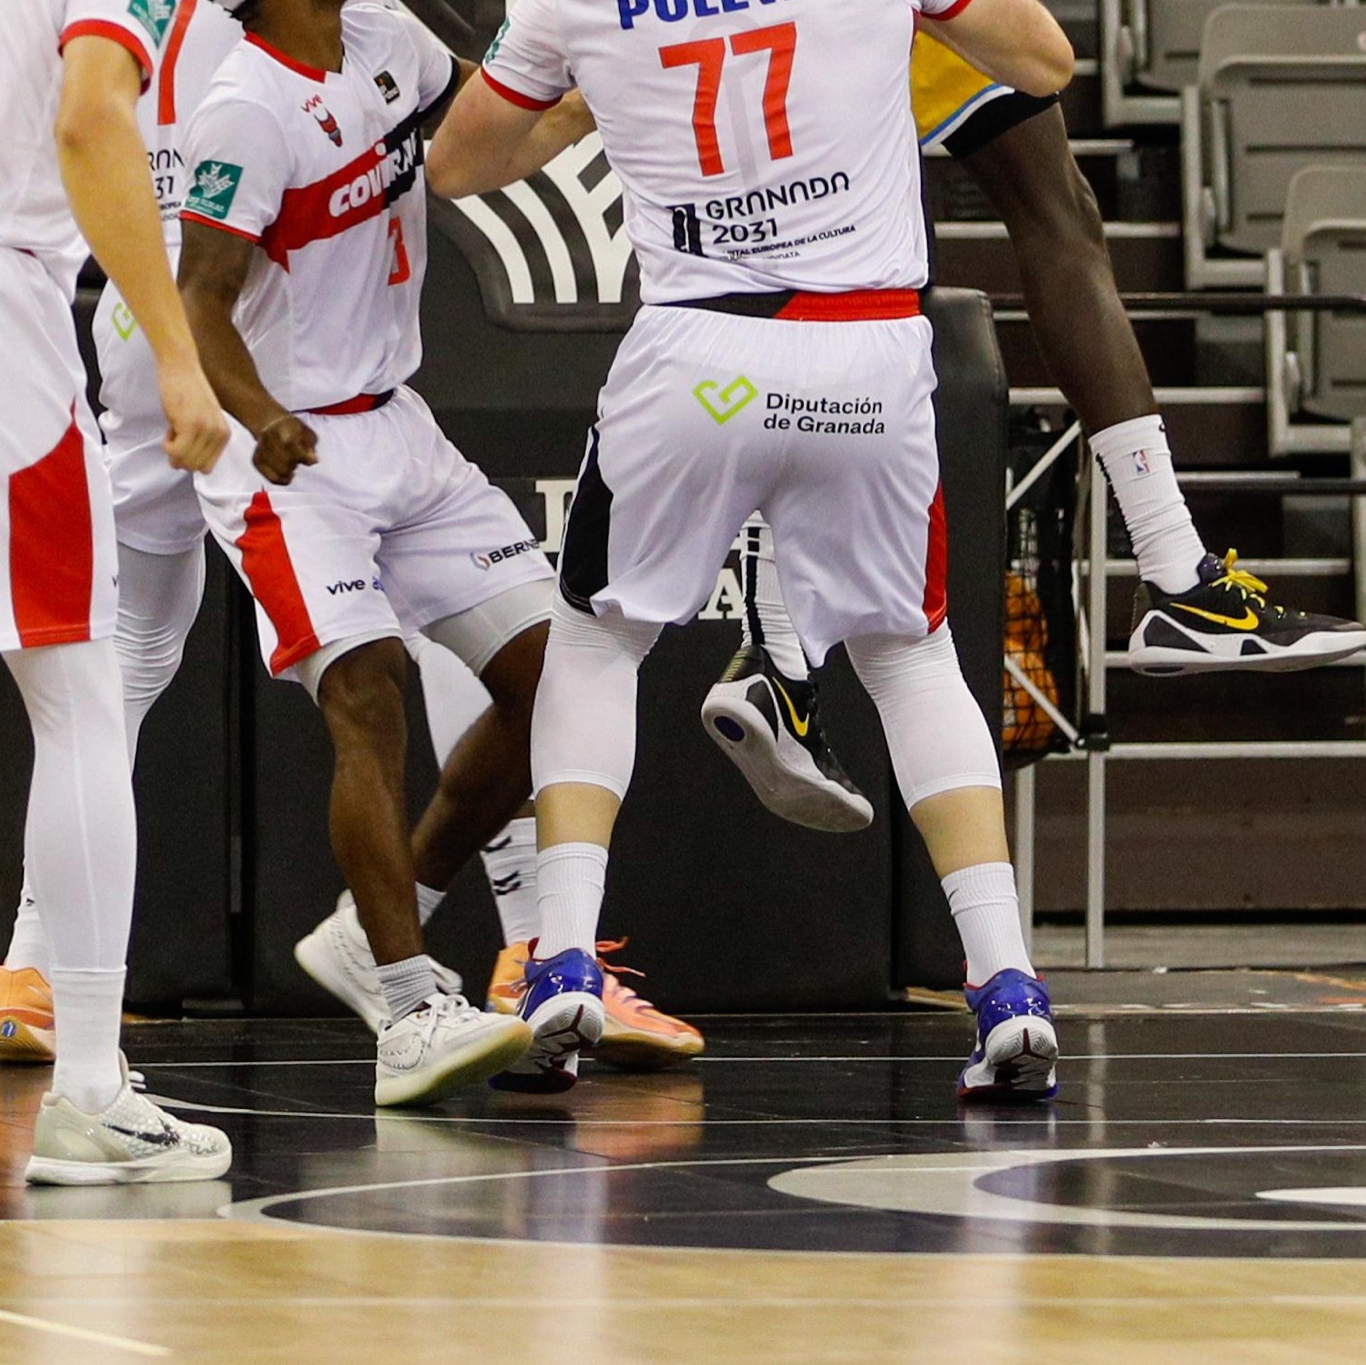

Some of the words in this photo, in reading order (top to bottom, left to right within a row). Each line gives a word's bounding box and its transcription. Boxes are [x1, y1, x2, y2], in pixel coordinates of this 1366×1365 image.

[659, 22, 797, 177] 77
[705, 172, 850, 220] GRANADA
[712, 218, 778, 245] 2031
[752, 241, 793, 255] EUROPEA
[795, 237, 806, 246] DE
[807, 234, 818, 243] LA
[819, 224, 856, 240] CULTURA
[387, 215, 412, 285] 3
[766, 391, 883, 417] Diputación
[763, 414, 790, 431] de
[797, 414, 885, 434] Granada
[326, 578, 366, 595] vive
